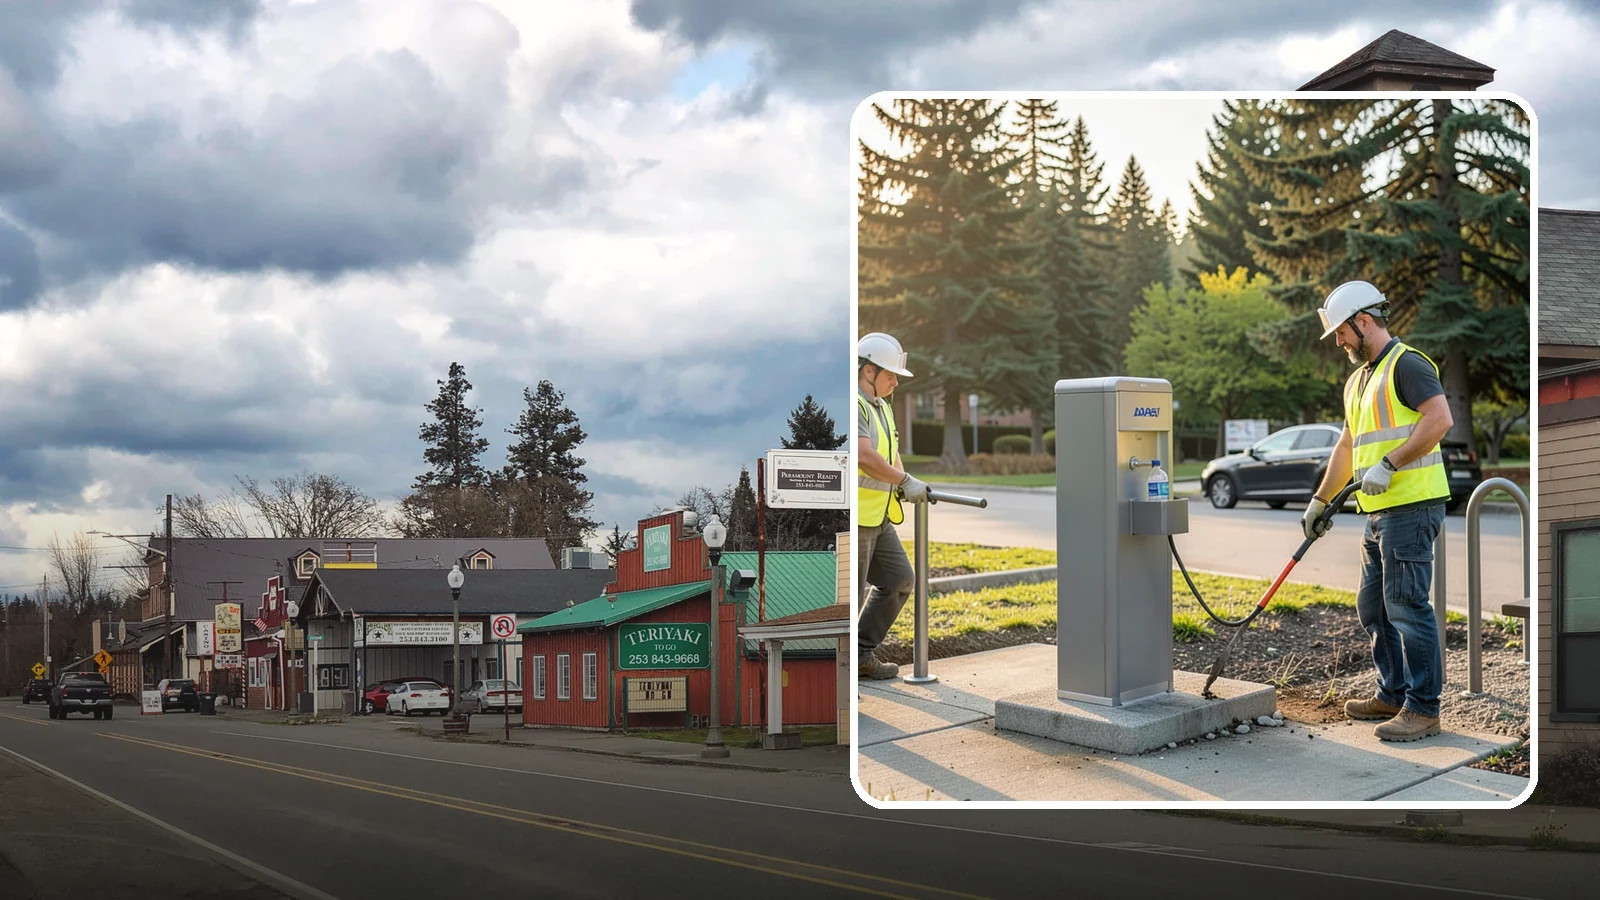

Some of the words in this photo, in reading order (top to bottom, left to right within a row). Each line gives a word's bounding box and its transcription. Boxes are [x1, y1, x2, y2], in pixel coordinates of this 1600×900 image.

[781, 471, 815, 480] PARAMOUNT
[817, 472, 839, 480] REALTY
[624, 627, 703, 646] TERIYAKI
[628, 654, 649, 665] 253
[651, 654, 700, 664] 843-9668
[639, 681, 672, 691] TERIYAKI
